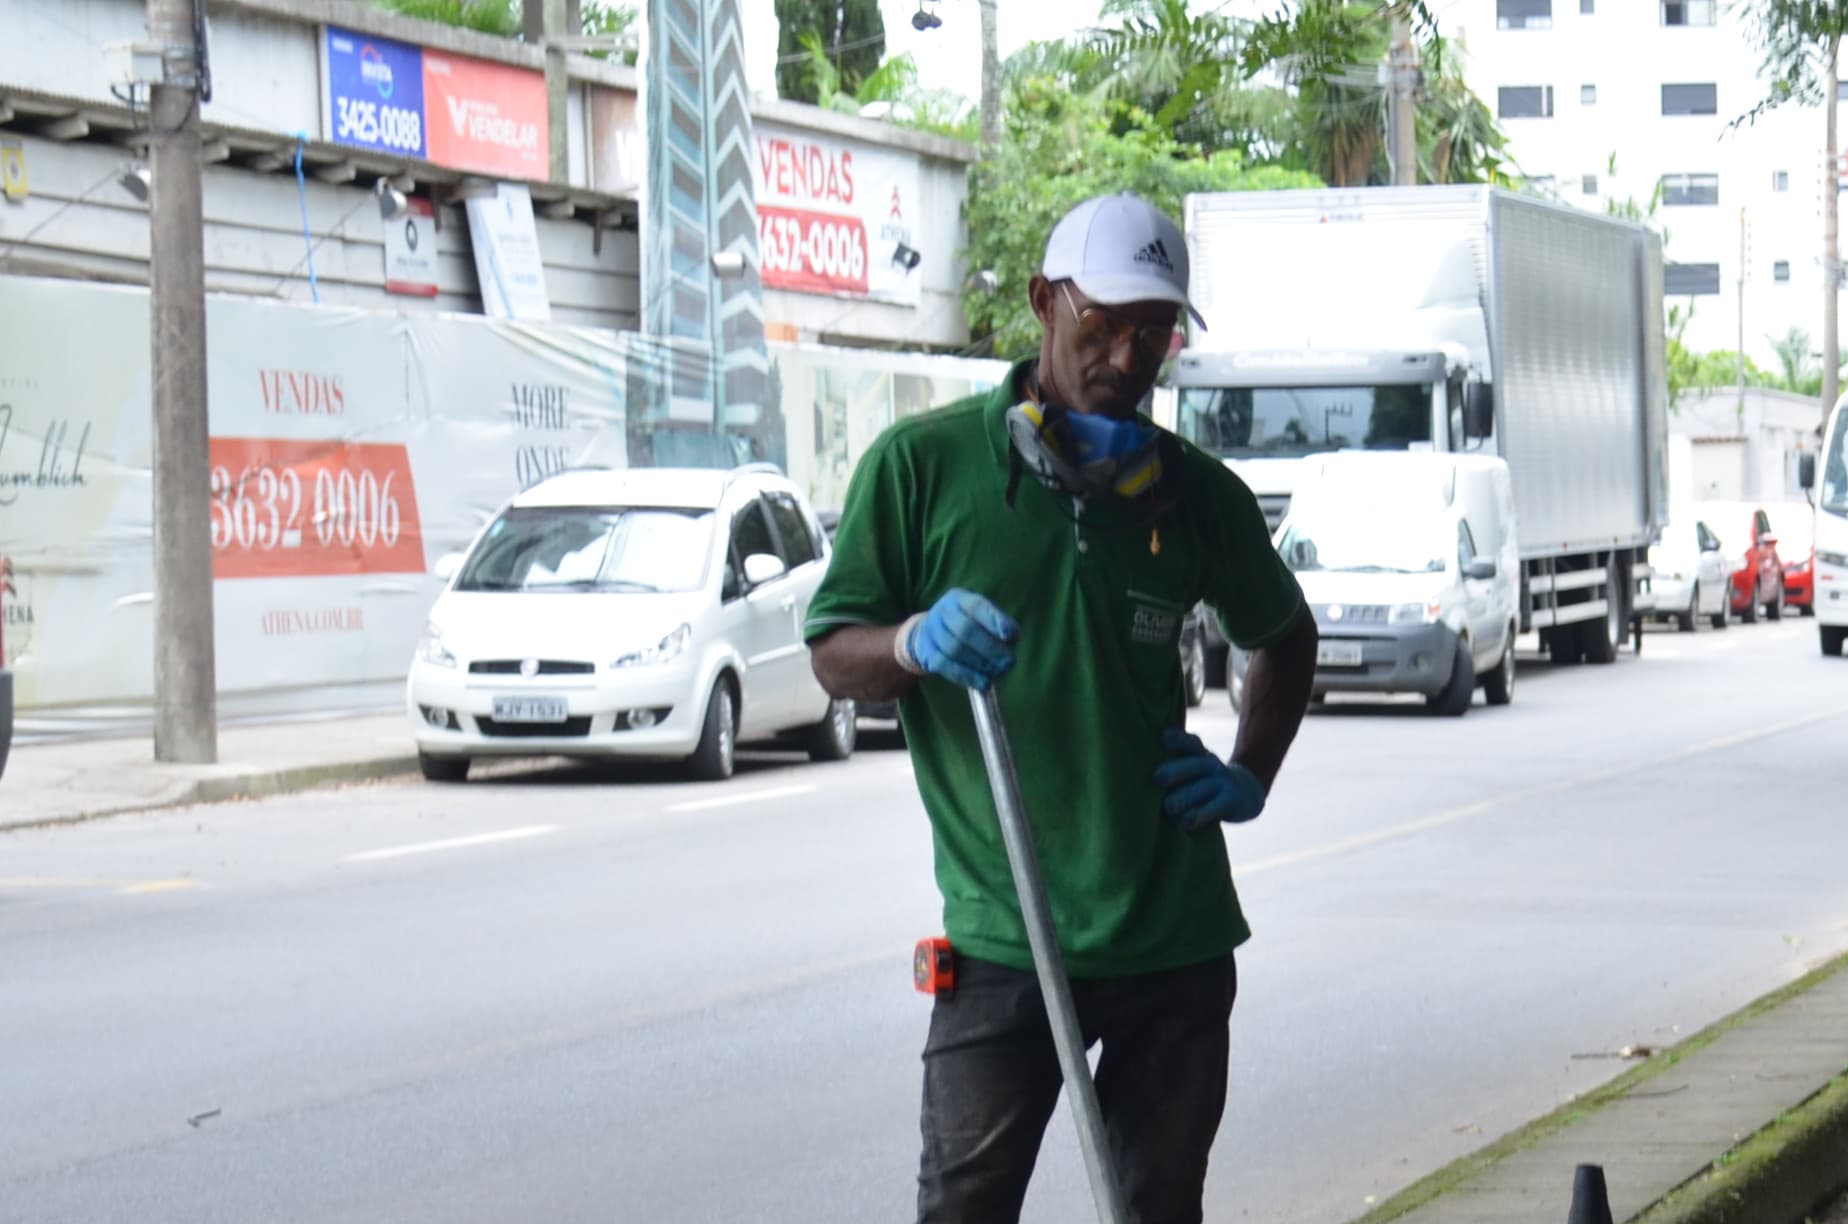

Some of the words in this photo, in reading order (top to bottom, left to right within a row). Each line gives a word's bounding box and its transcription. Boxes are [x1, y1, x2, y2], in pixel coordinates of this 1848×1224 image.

[757, 136, 854, 205] VENDAS
[258, 368, 345, 416] VENDAS
[511, 382, 571, 430] MORE
[210, 464, 302, 549] 3632
[313, 467, 400, 549] 0006
